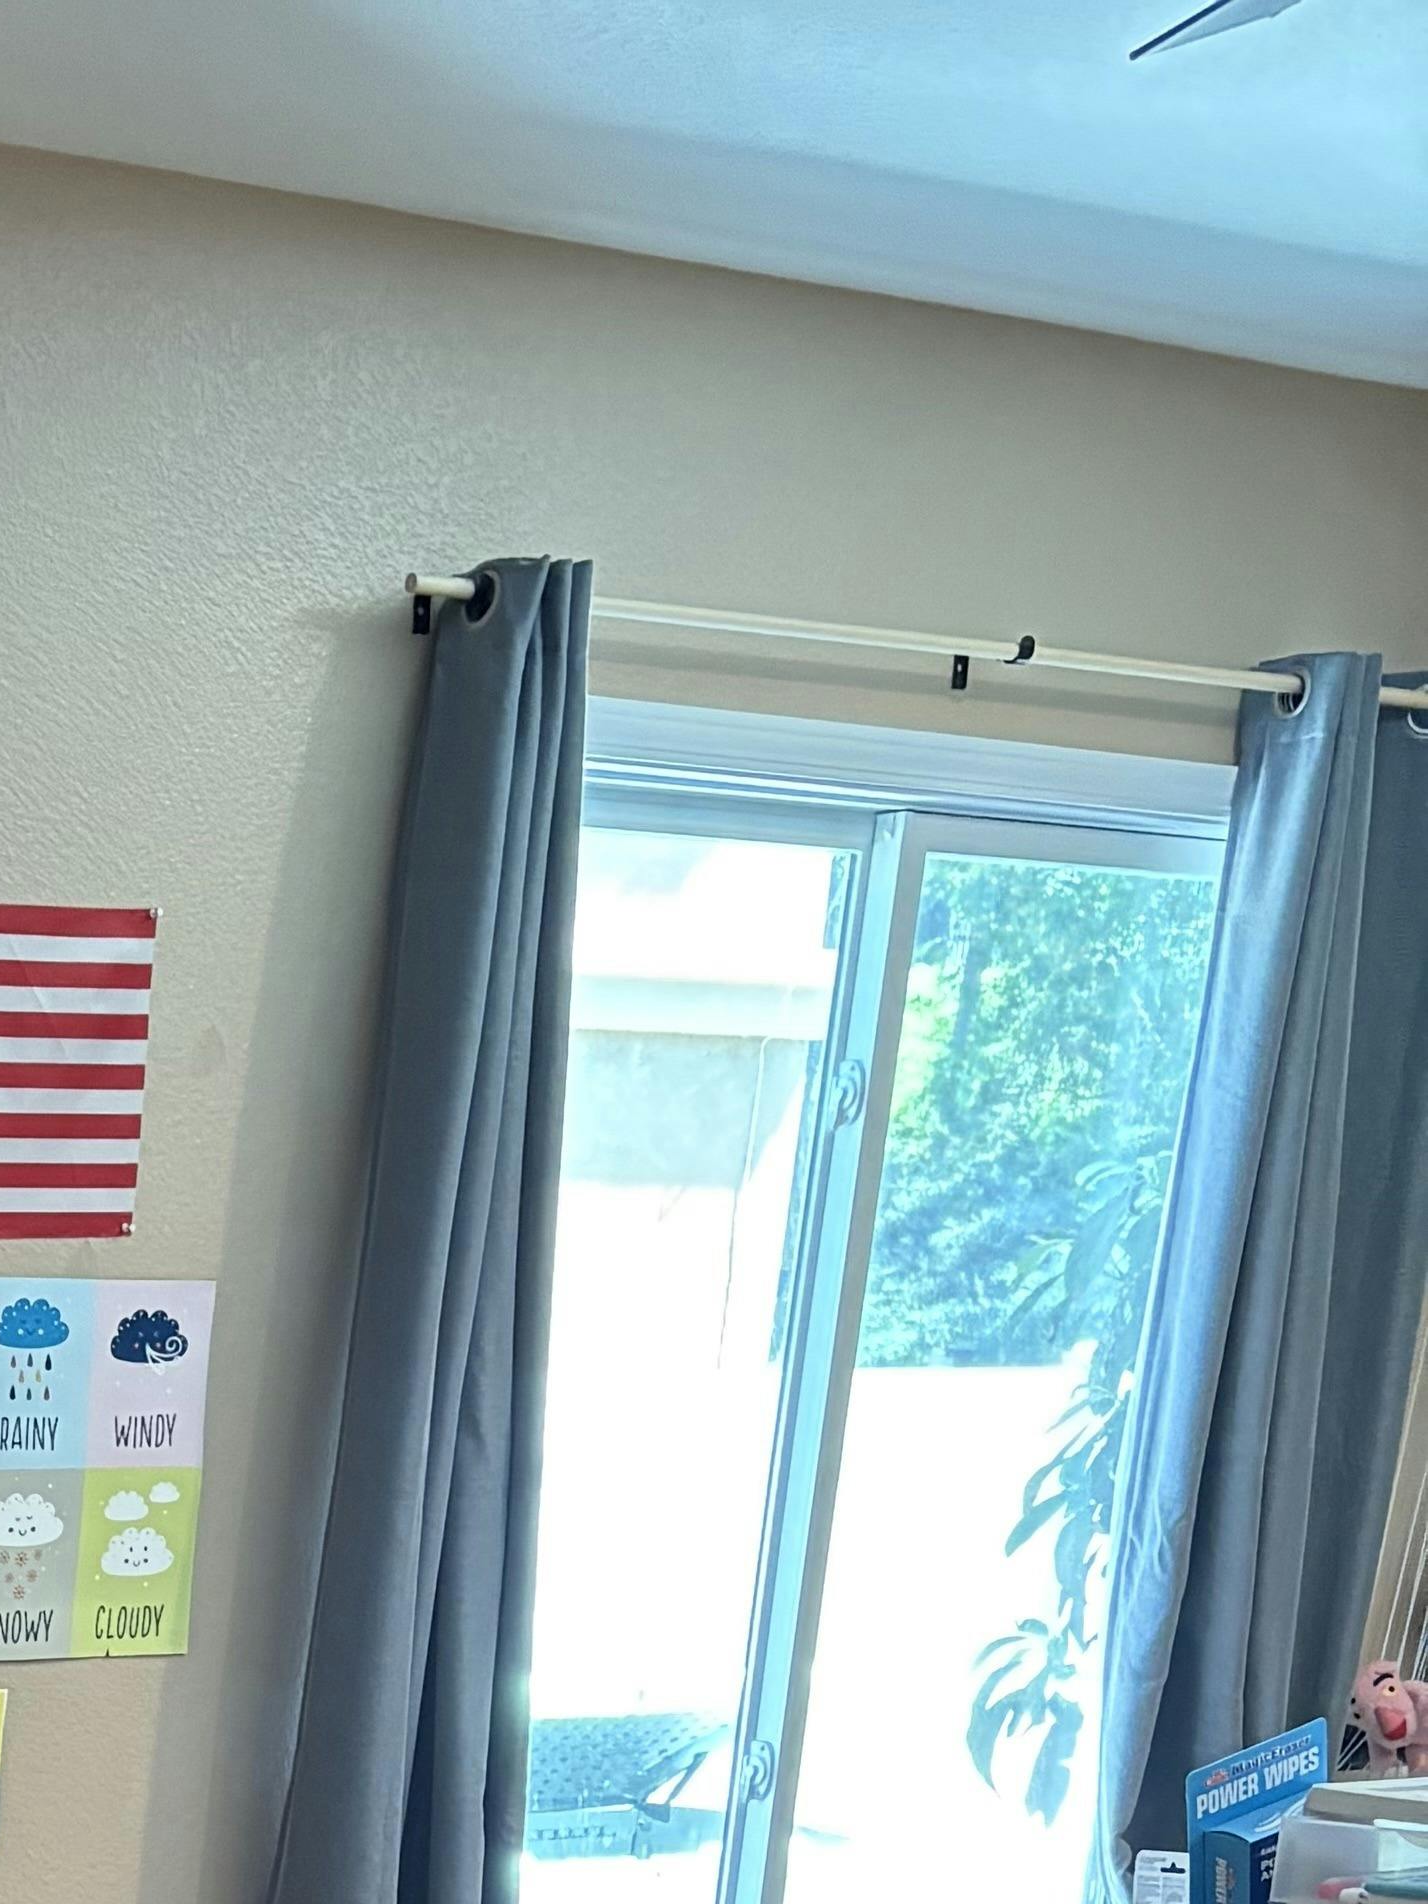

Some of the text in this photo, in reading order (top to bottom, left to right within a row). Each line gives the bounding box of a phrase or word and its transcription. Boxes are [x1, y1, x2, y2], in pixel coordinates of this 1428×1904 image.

[0, 1416, 58, 1451] RAINY
[114, 1413, 176, 1448] WINDY
[95, 1604, 165, 1640] CLOUDY
[1196, 1745, 1321, 1820] POWER WIPES
